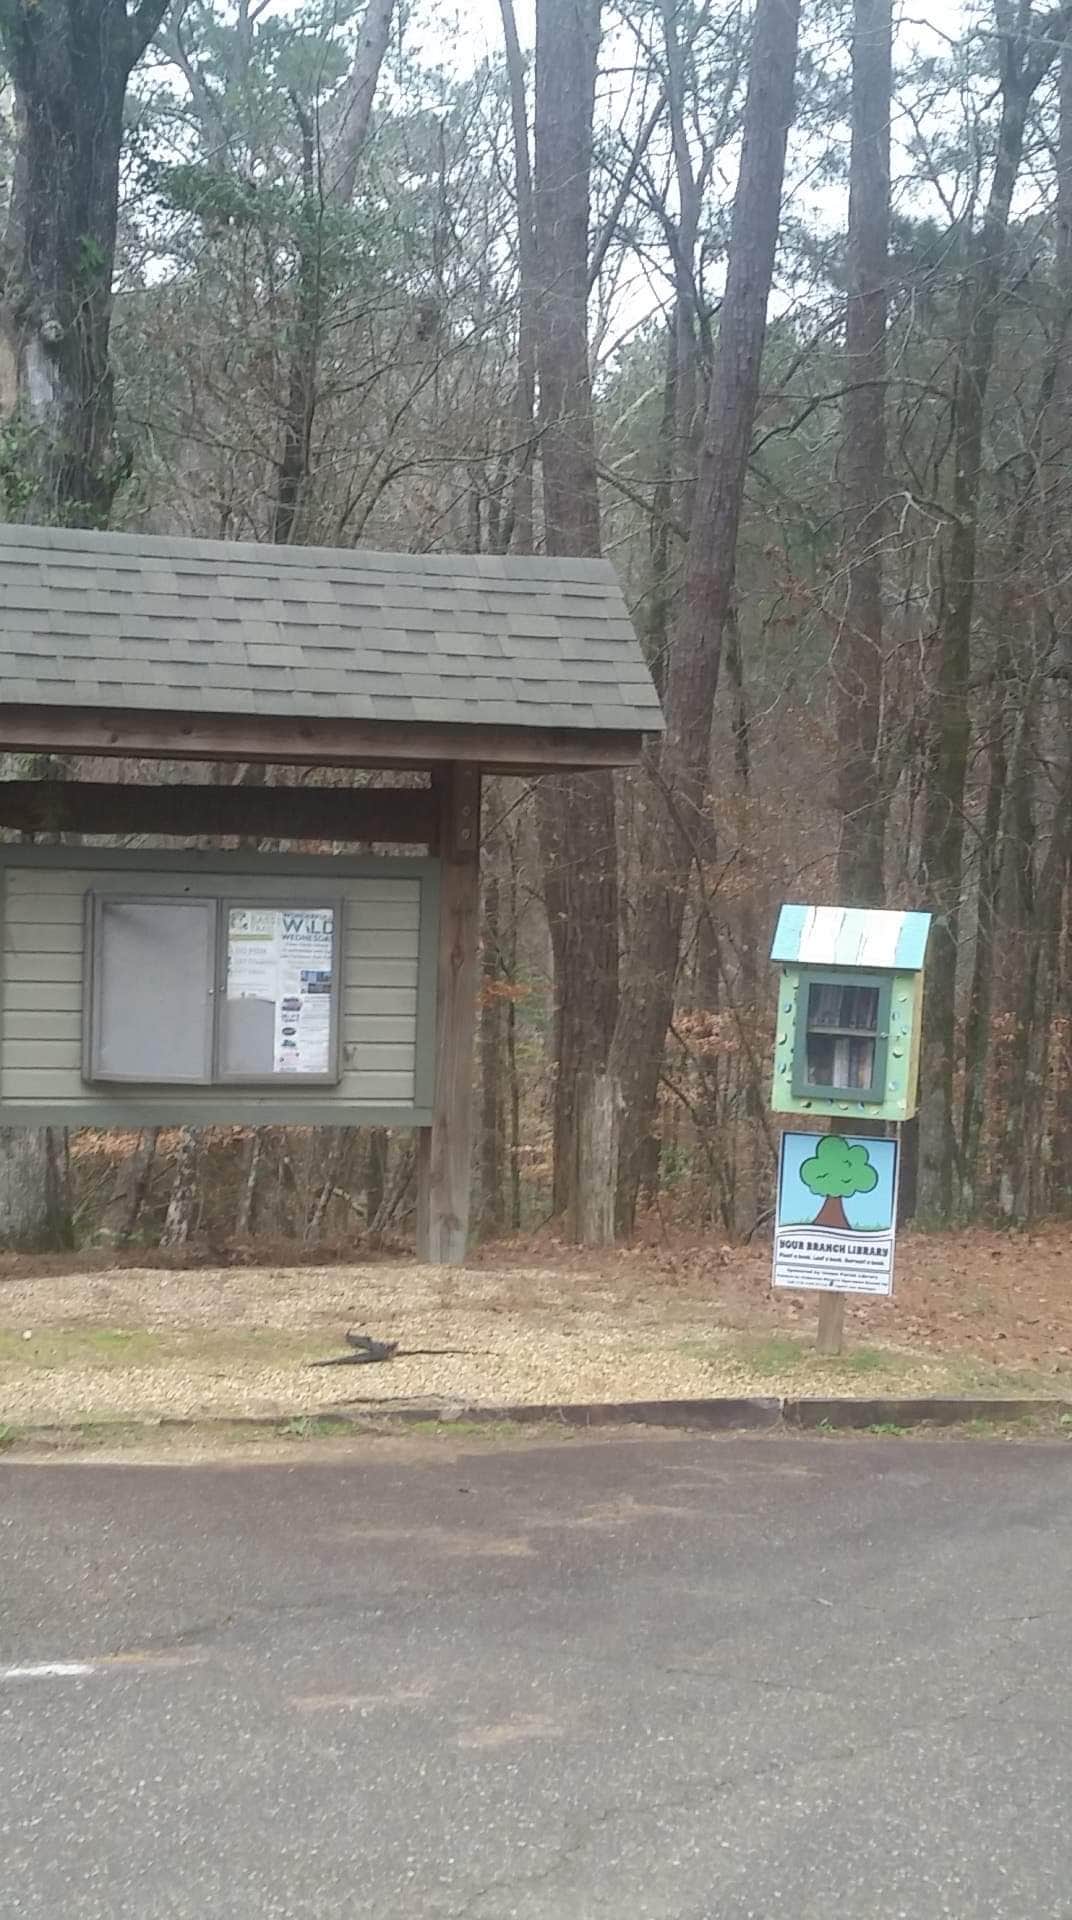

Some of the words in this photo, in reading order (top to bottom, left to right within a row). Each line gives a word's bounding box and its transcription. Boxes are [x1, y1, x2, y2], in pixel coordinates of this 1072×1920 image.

[282, 934, 331, 942] WEDNESDA
[779, 1239, 804, 1250] YOUR
[806, 1242, 846, 1254] BRANCH
[847, 1245, 889, 1257] LIBRARY
